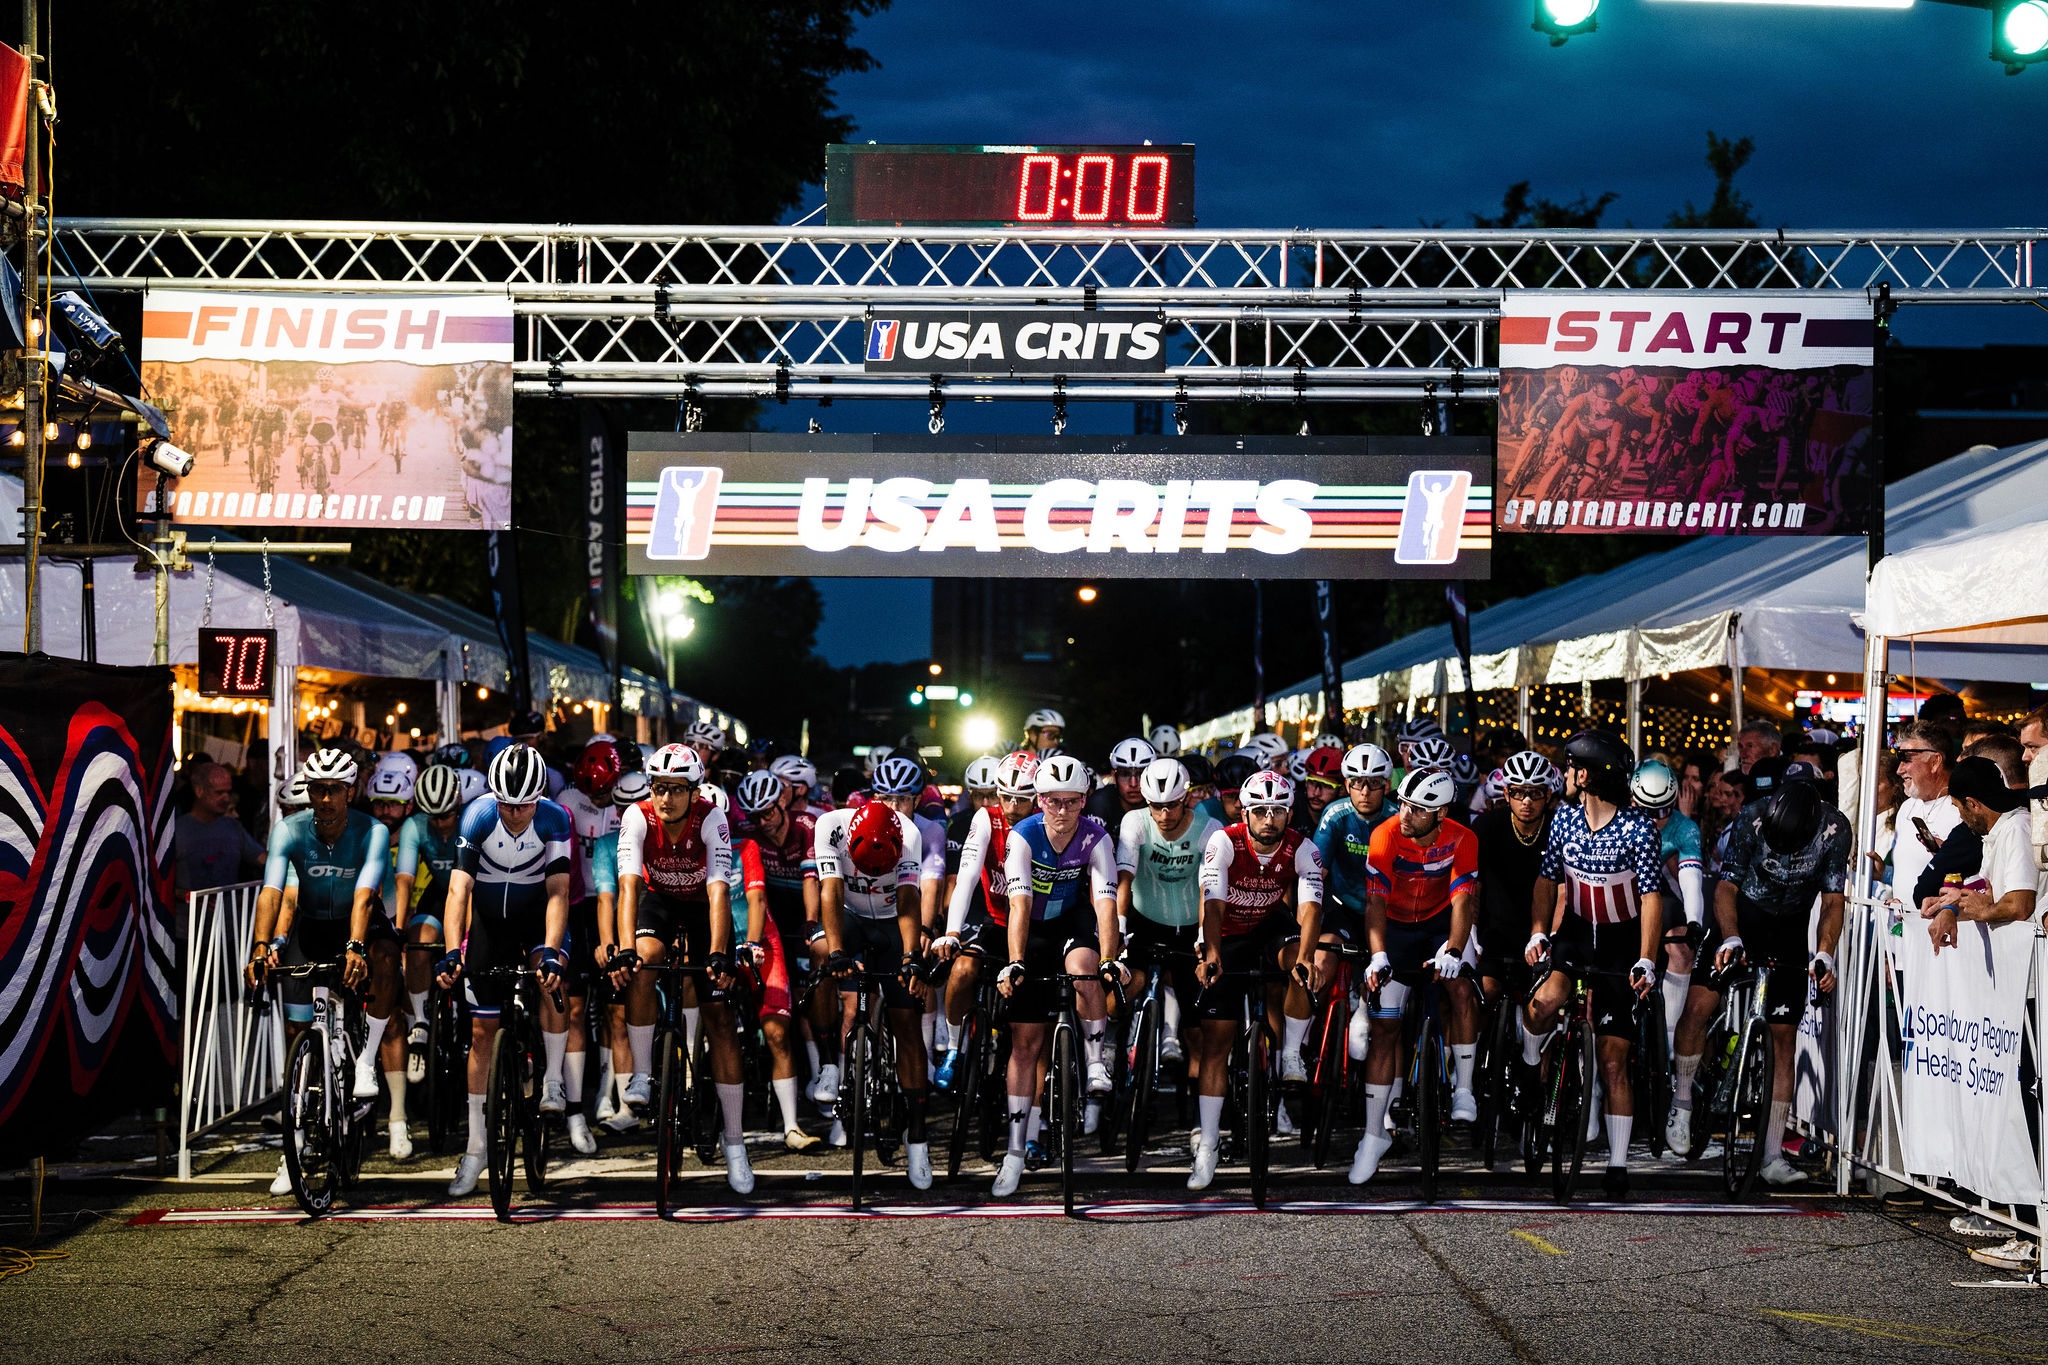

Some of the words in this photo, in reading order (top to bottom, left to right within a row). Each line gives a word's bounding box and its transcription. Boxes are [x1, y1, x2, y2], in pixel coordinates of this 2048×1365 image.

[78, 312, 101, 333] LYNX
[193, 306, 440, 351] FINISH
[902, 322, 1004, 360] USA
[1014, 322, 1160, 360] CRITS
[1553, 311, 1801, 354] START
[797, 477, 1001, 553] USA
[1022, 478, 1319, 556] CRITS
[1503, 498, 1806, 529] SPARTANBURGCRIT.COM
[1428, 776, 1449, 788] TREK
[1562, 842, 1618, 862] CADENCE
[859, 992, 867, 1012] BMC
[1916, 1005, 1979, 1052] Spaburg
[1981, 1017, 2019, 1058] Region
[1967, 1057, 2004, 1096] System
